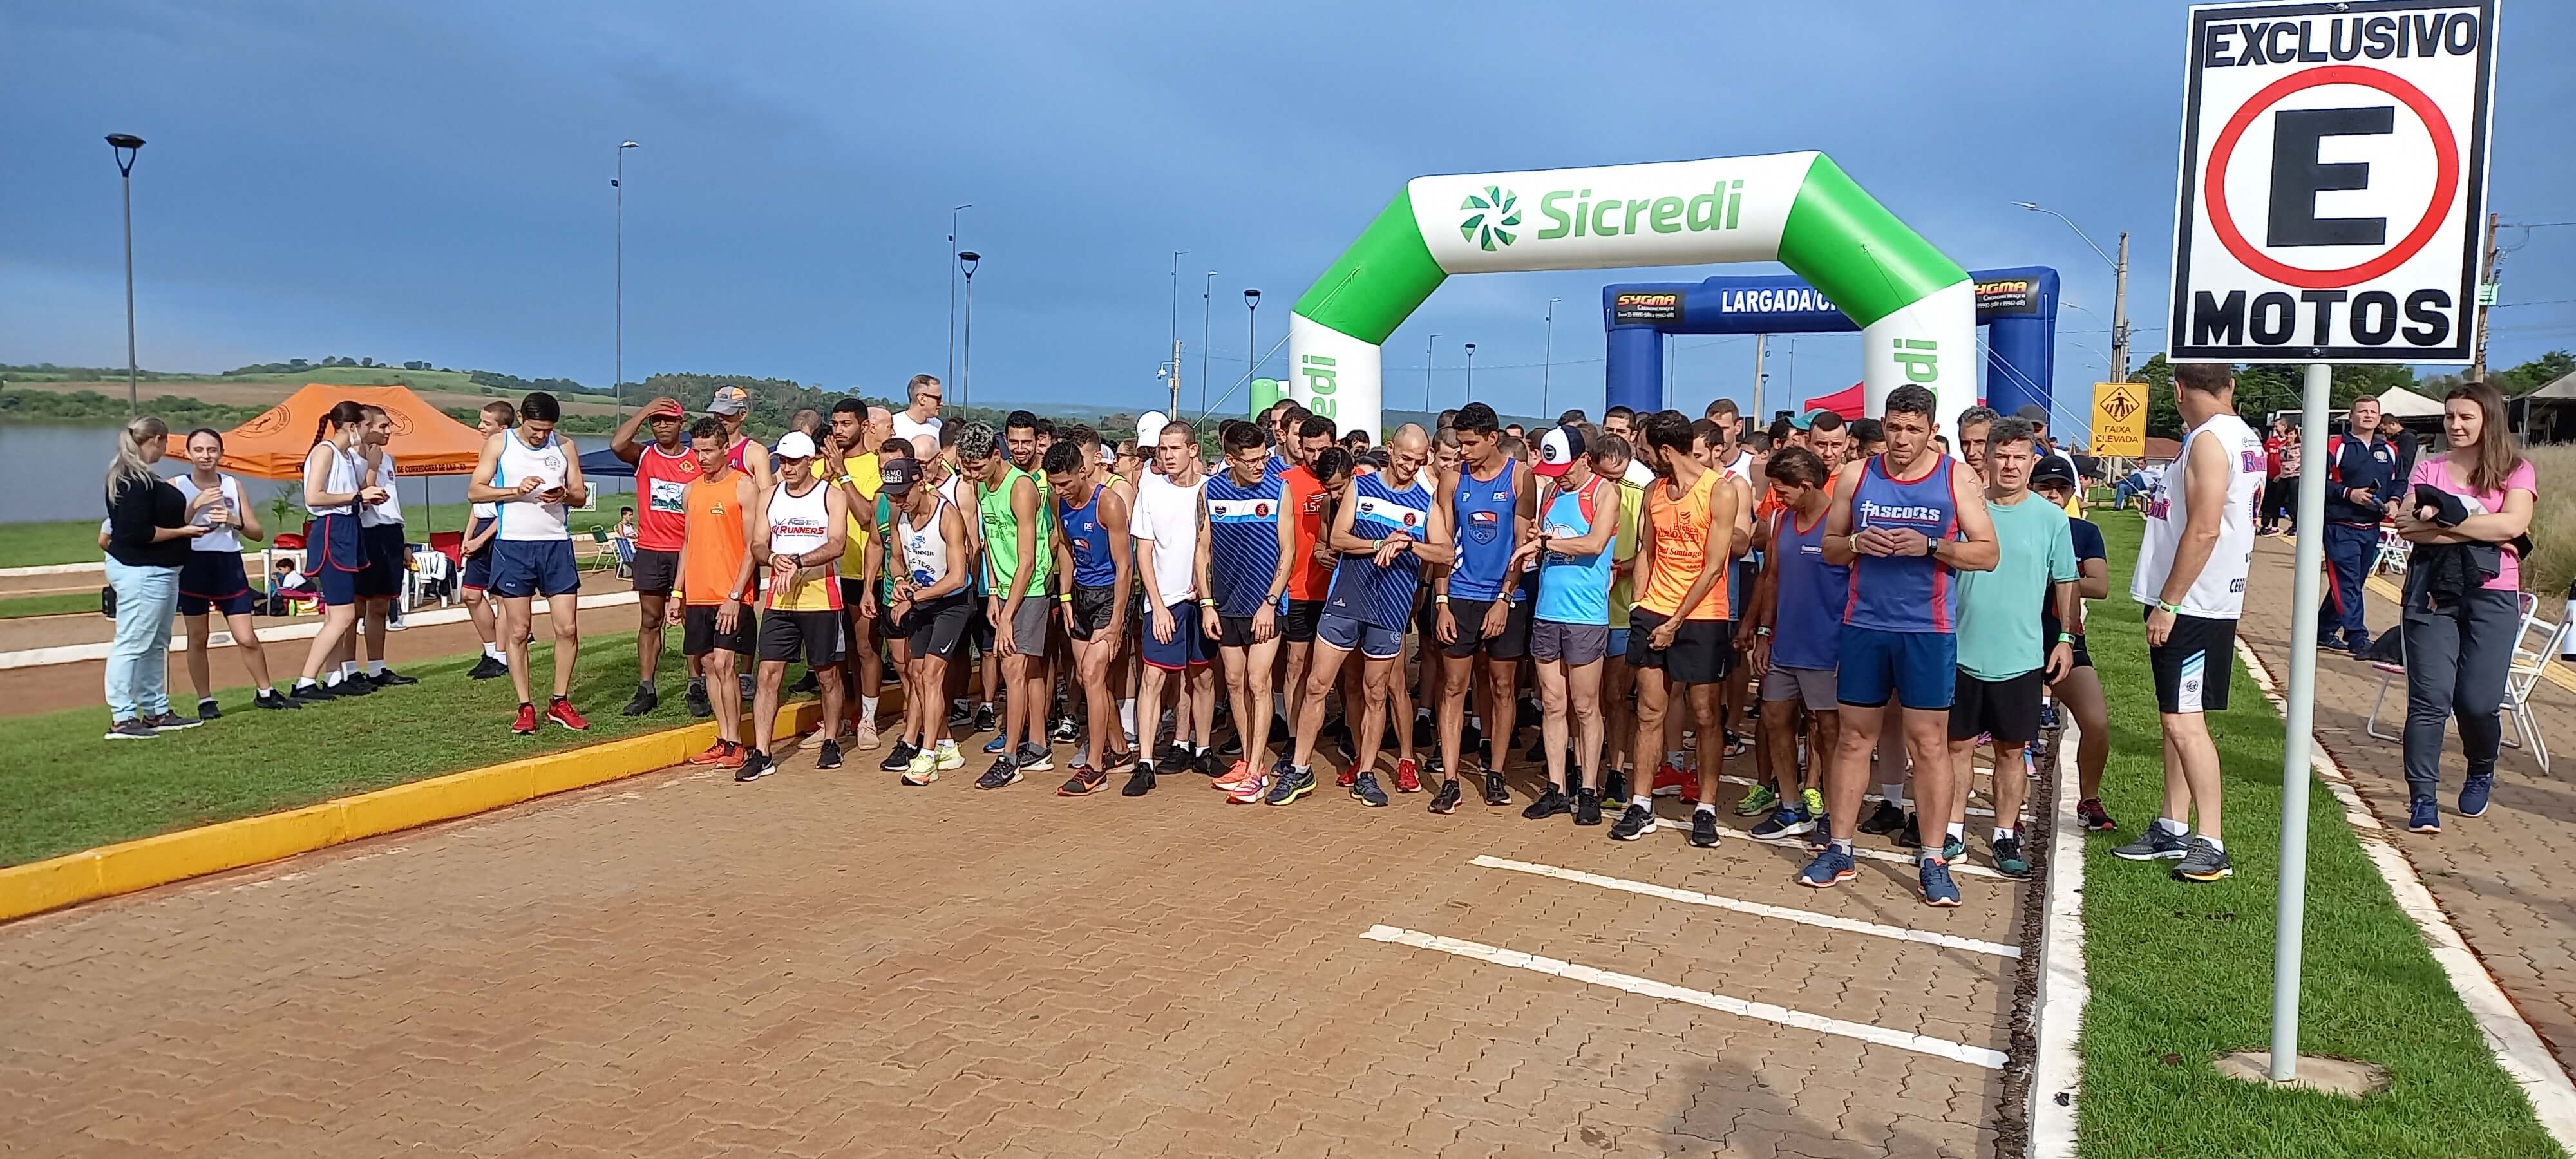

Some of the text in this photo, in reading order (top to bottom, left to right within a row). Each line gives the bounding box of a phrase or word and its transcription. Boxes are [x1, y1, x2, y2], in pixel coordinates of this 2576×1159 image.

[2205, 14, 2478, 67] EXCLUSIVO
[2266, 106, 2395, 247] E
[1538, 180, 1744, 239] Sicredi
[1618, 295, 1676, 306] SYGMA
[1722, 289, 1836, 313] LARGADA/C
[1973, 281, 2027, 295] YGMA
[2192, 289, 2452, 346] MOTOS
[1893, 338, 1938, 405] di
[2096, 435, 2139, 444] ELEVADA
[780, 525, 825, 534] RUNNERS
